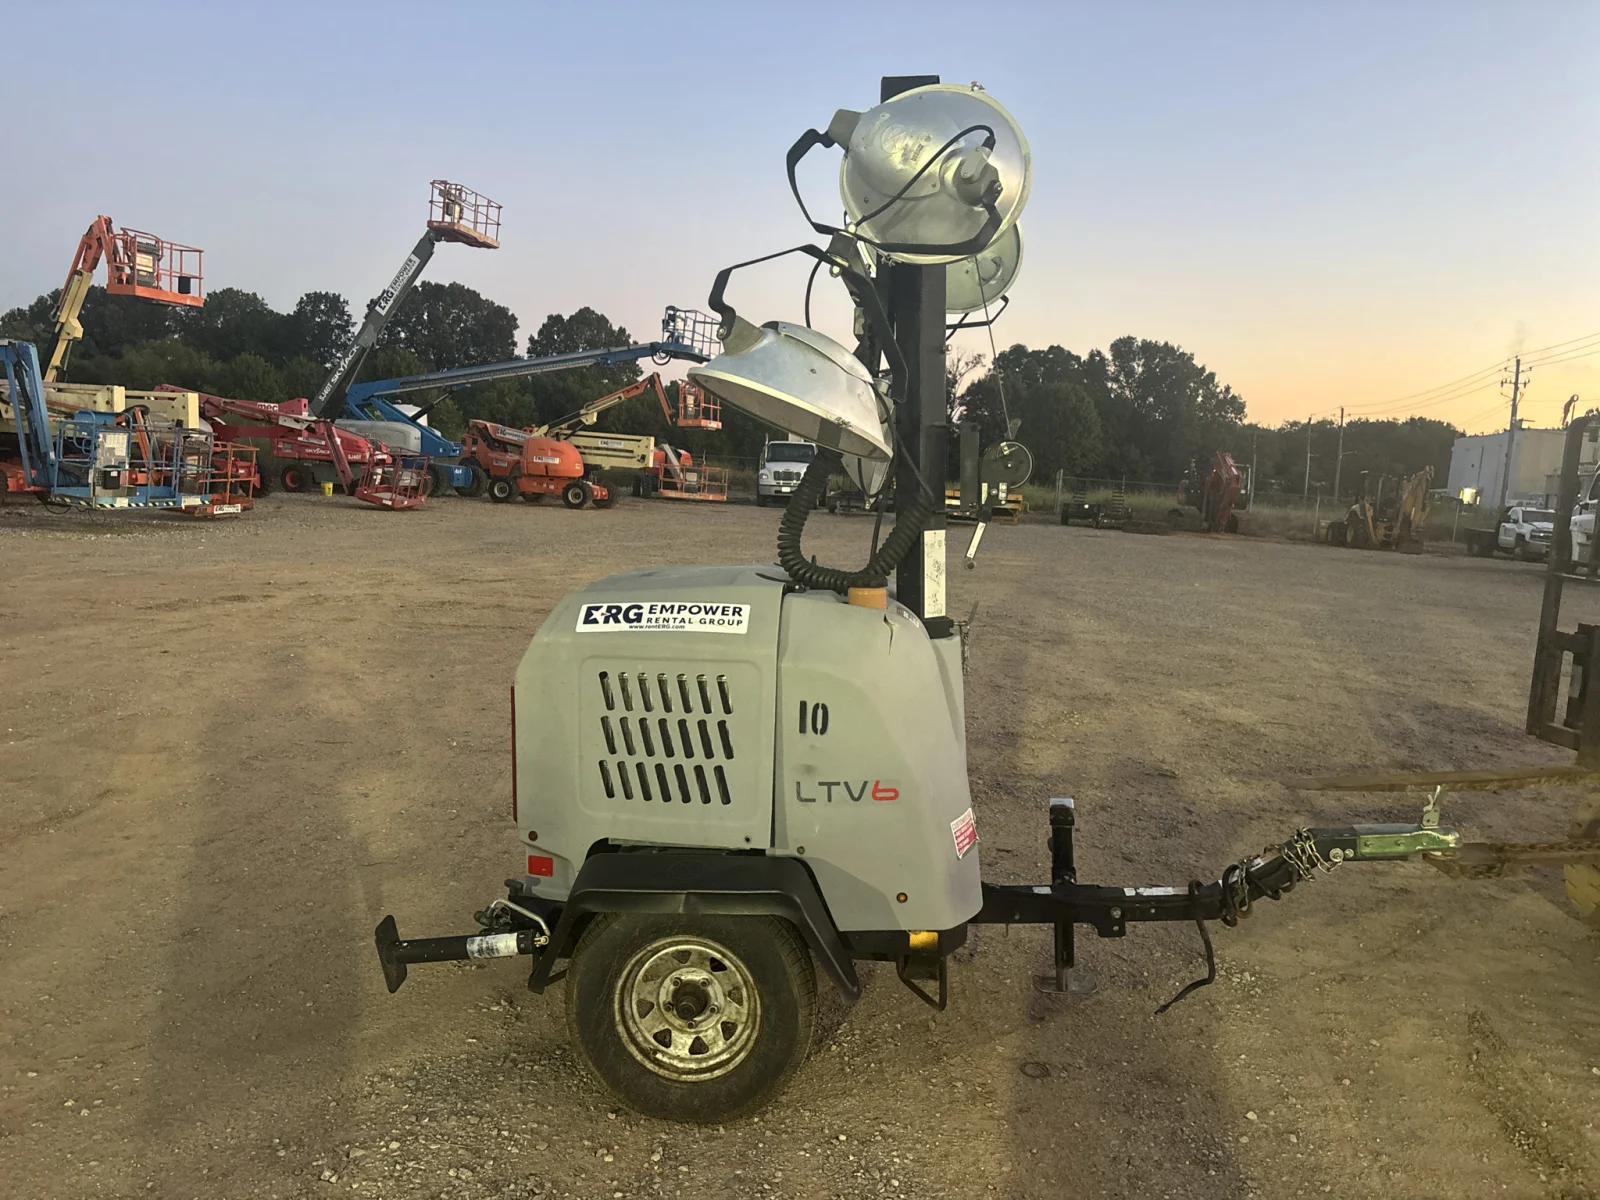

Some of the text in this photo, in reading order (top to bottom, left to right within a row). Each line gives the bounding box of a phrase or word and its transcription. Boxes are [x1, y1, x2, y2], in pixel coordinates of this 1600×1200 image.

[390, 257, 414, 290] EMPOWER
[378, 289, 395, 310] ERG
[331, 344, 360, 383] SKYJACK
[258, 403, 278, 411] mec
[583, 604, 643, 624] ERG
[648, 604, 743, 616] EMPOWER
[699, 618, 743, 626] GROUP
[799, 700, 829, 735] 10
[796, 780, 899, 802] LTV6
